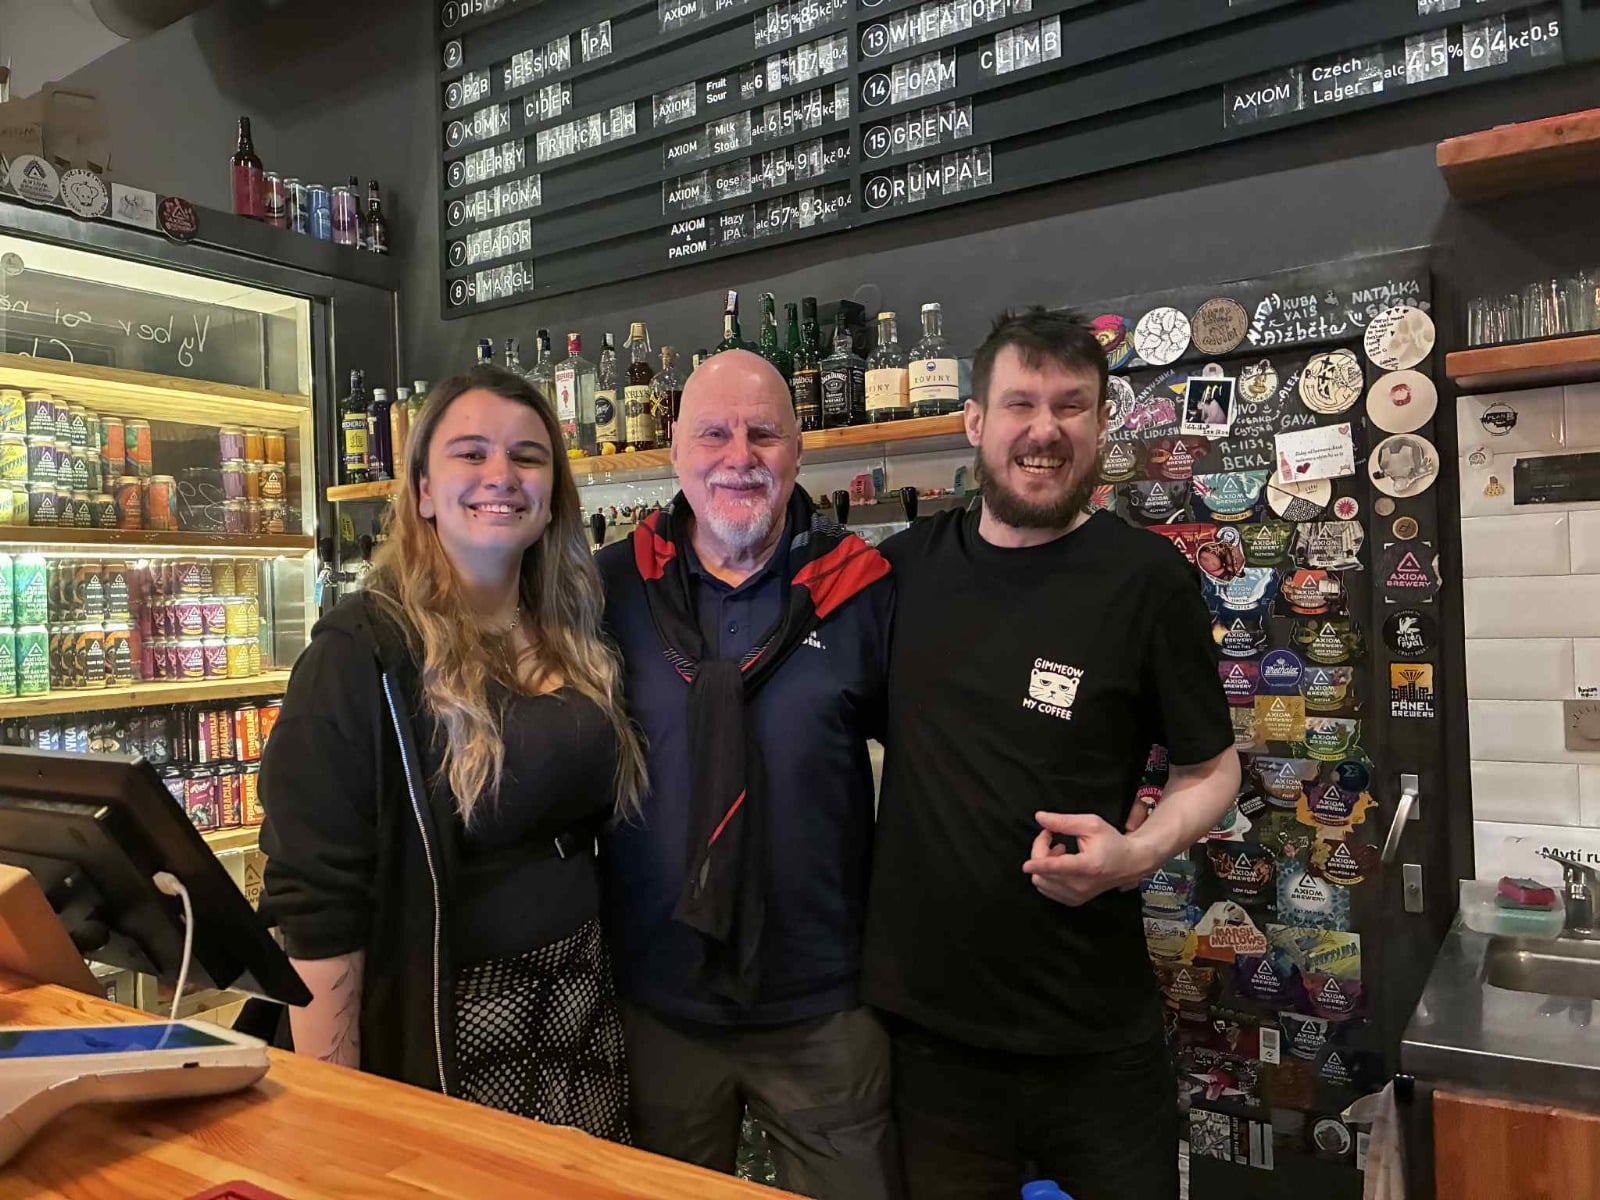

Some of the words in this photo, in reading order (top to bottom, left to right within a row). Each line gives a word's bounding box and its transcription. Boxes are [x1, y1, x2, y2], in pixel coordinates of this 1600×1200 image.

[868, 33, 884, 48] 13
[465, 79, 488, 98] B2B
[505, 47, 568, 84] SESSION
[583, 33, 610, 57] IPA
[664, 4, 697, 23] AXIOM
[870, 81, 885, 97] 14
[895, 62, 955, 93] FOAM
[981, 32, 1057, 69] CLIMB
[1233, 85, 1290, 110] AXIOM
[1383, 63, 1405, 80] alc
[1470, 30, 1506, 60] 64
[1530, 21, 1559, 42] 0,5
[1312, 58, 1362, 81] Czech
[706, 78, 726, 91] Fruit
[1313, 81, 1361, 104] Lager
[706, 90, 727, 104] Sour
[464, 112, 507, 138] KOMIX
[526, 91, 570, 118] CIDER
[715, 122, 735, 137] Milk
[871, 134, 885, 149] 15
[894, 111, 969, 144] GRENA
[467, 148, 524, 178] CHERRY
[538, 114, 633, 154] TRITICALER
[659, 99, 689, 116] AXIOM
[668, 141, 697, 159] AXIOM
[751, 125, 764, 137] alc
[714, 138, 739, 154] Stout
[872, 185, 886, 199] 16
[894, 159, 987, 196] RUMPAL
[468, 230, 529, 257] IDEADOR
[668, 187, 699, 203] AXIOM
[716, 176, 739, 190] Gose
[720, 213, 744, 227] Hazy
[671, 218, 705, 235] AXIOM
[723, 229, 741, 241] IPA
[668, 241, 707, 259] PAROM
[1283, 295, 1318, 311] KUBA
[1284, 306, 1318, 322] VAIS
[1237, 403, 1258, 416] IVO
[1281, 414, 1316, 429] GAYA
[1223, 454, 1266, 470] BEKA
[1389, 573, 1427, 581] AXIOM
[1034, 657, 1084, 678] GIMMEOW
[1022, 698, 1037, 710] MY
[1038, 703, 1072, 720] COFFEE
[1391, 711, 1434, 719] BREWERY
[210, 711, 219, 759] MARACUJA
[220, 711, 230, 758] MARACUJA
[223, 775, 233, 824] MARACUJA
[1291, 894, 1325, 902] BREWERY
[1294, 888, 1323, 896] AXIOM
[1211, 934, 1265, 946] MALLOWS
[1215, 927, 1254, 938] MARSH
